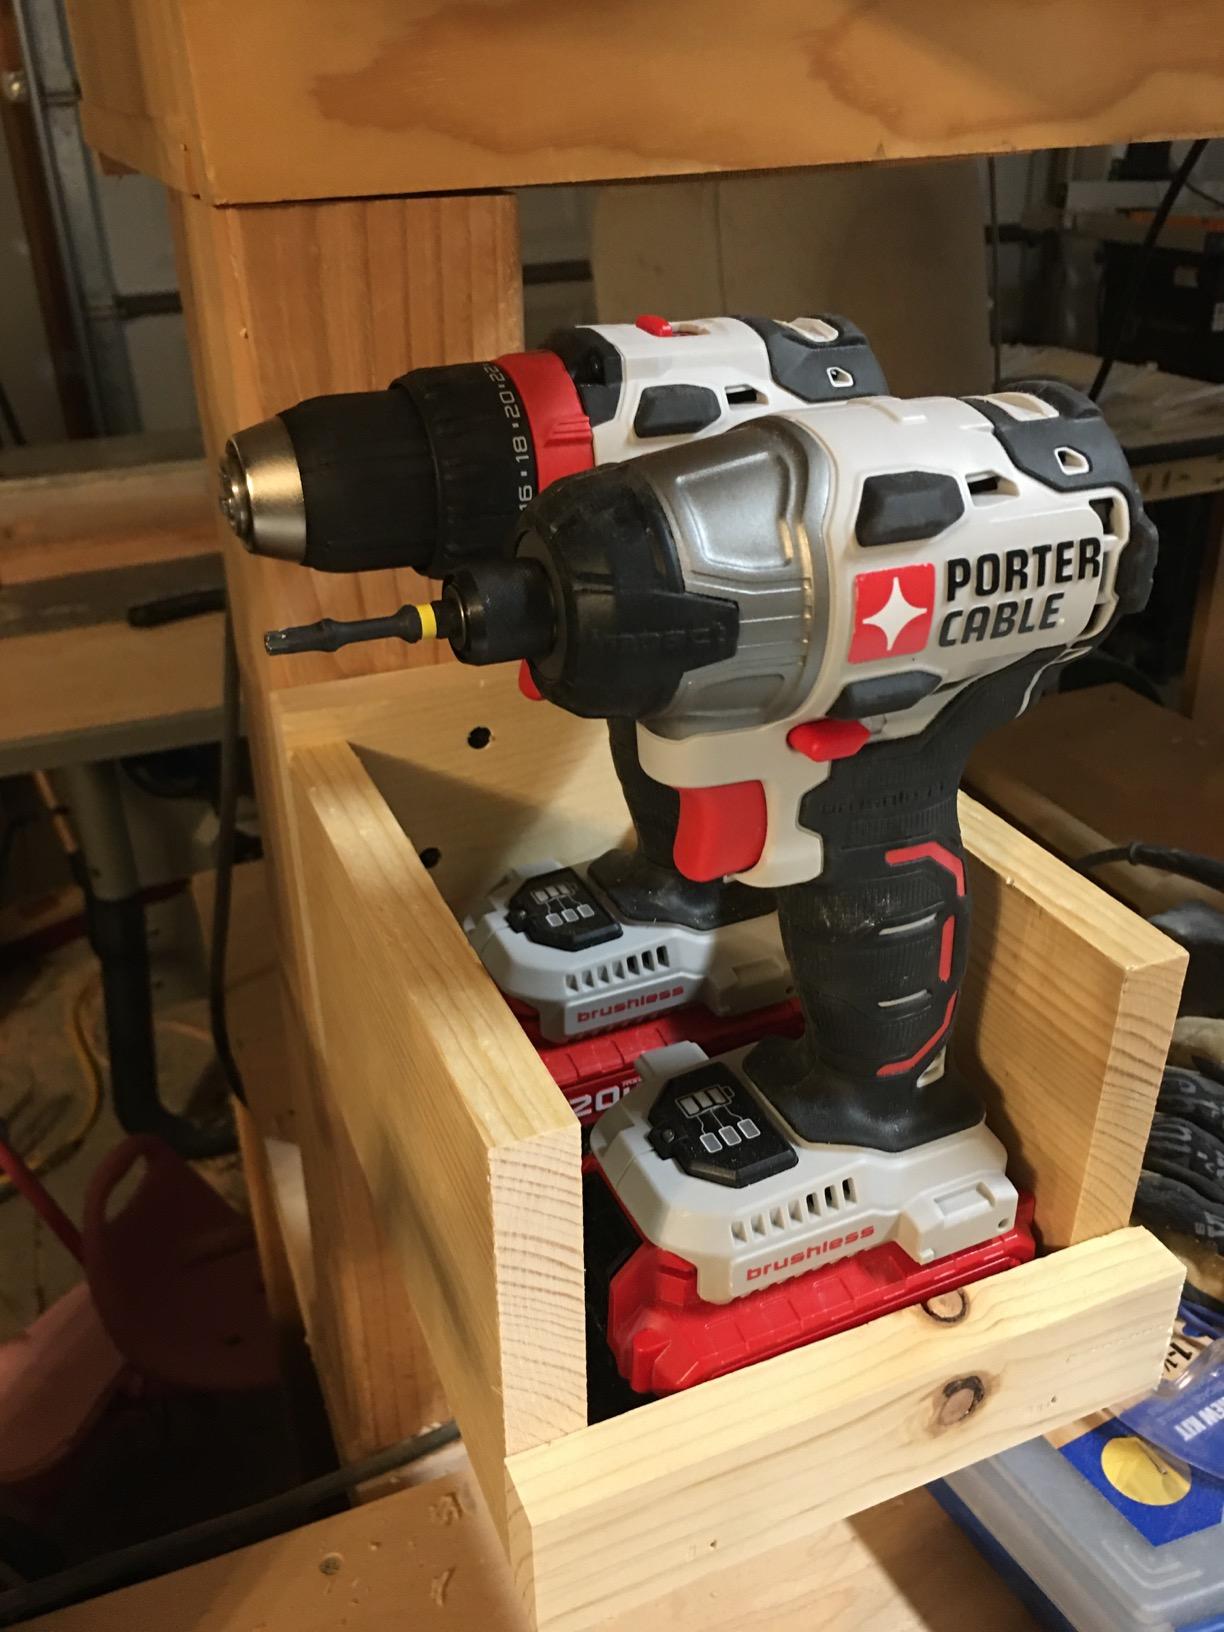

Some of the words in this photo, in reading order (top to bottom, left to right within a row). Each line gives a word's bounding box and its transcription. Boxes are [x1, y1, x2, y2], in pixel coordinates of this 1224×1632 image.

[500, 391, 520, 418] 20
[512, 436, 529, 463] 18
[946, 537, 1101, 602] PORTER
[938, 593, 1065, 647] CABLE
[576, 985, 685, 1023] brushless
[746, 1225, 875, 1281] brushless
